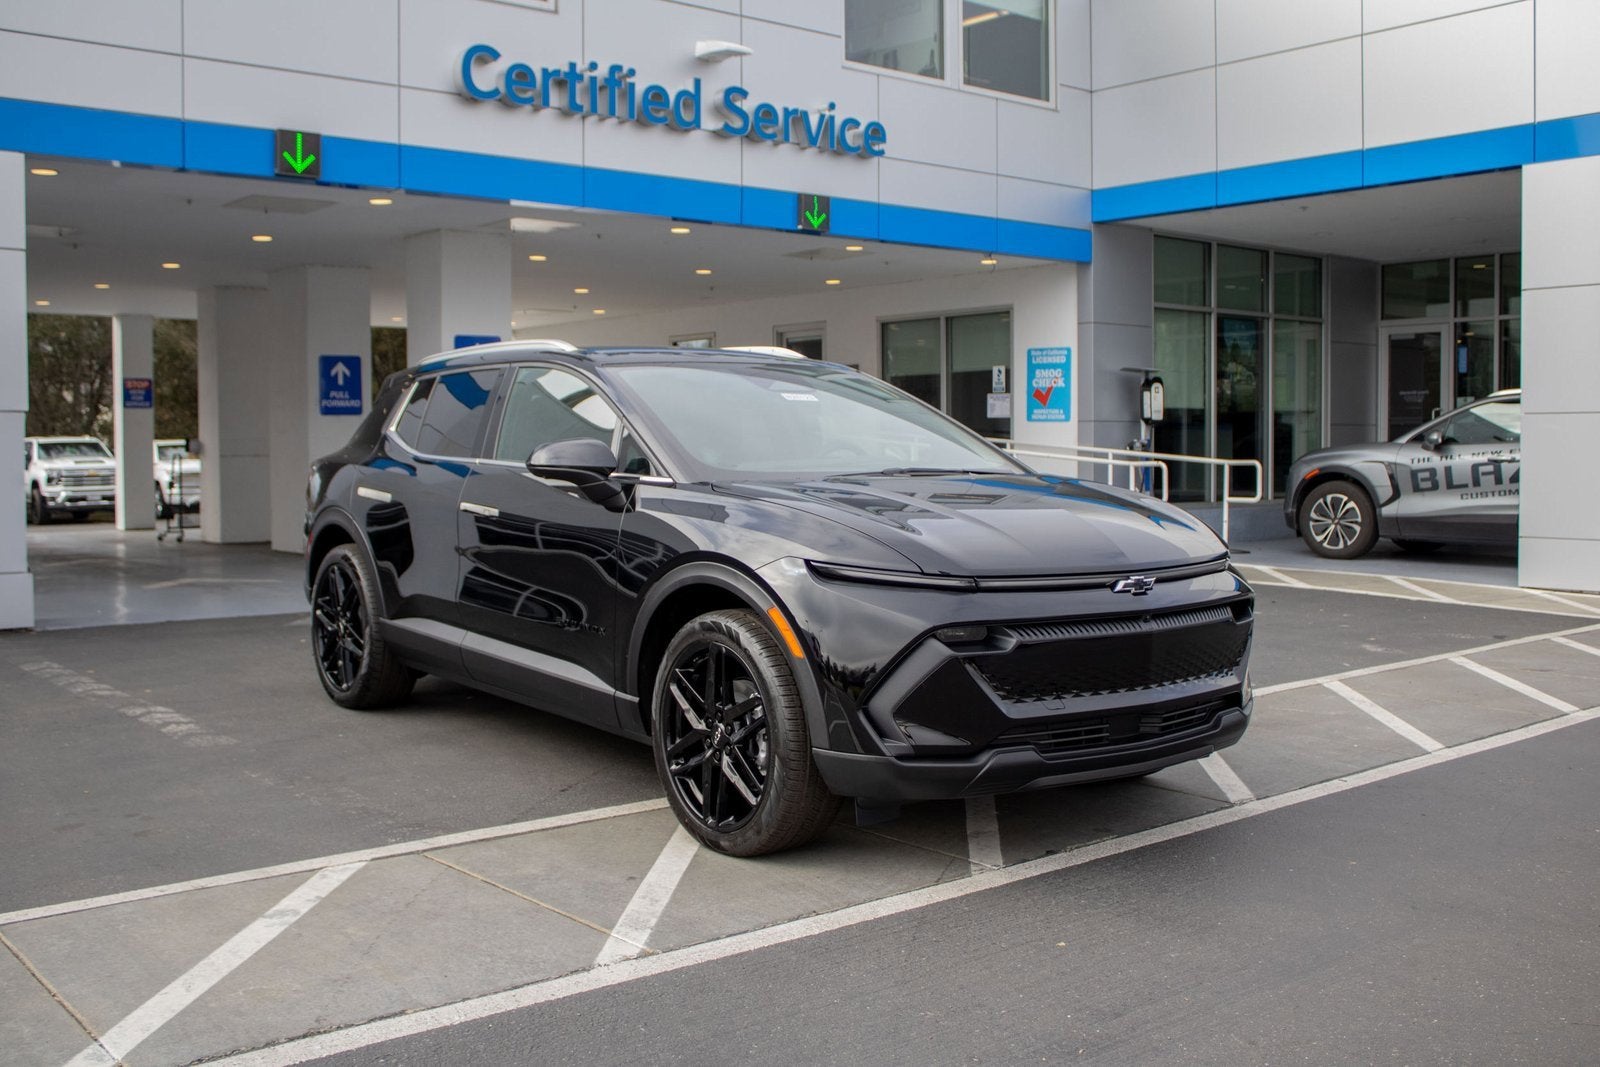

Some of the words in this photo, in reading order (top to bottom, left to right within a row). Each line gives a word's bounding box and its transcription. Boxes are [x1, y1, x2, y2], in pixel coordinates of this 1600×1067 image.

[461, 43, 702, 130] Certified
[722, 85, 888, 158] Service
[1032, 356, 1066, 364] LICENSED
[1035, 368, 1063, 378] SMOG
[1032, 377, 1066, 388] CHECK
[329, 390, 350, 399] PULL
[321, 399, 361, 408] FORWARD
